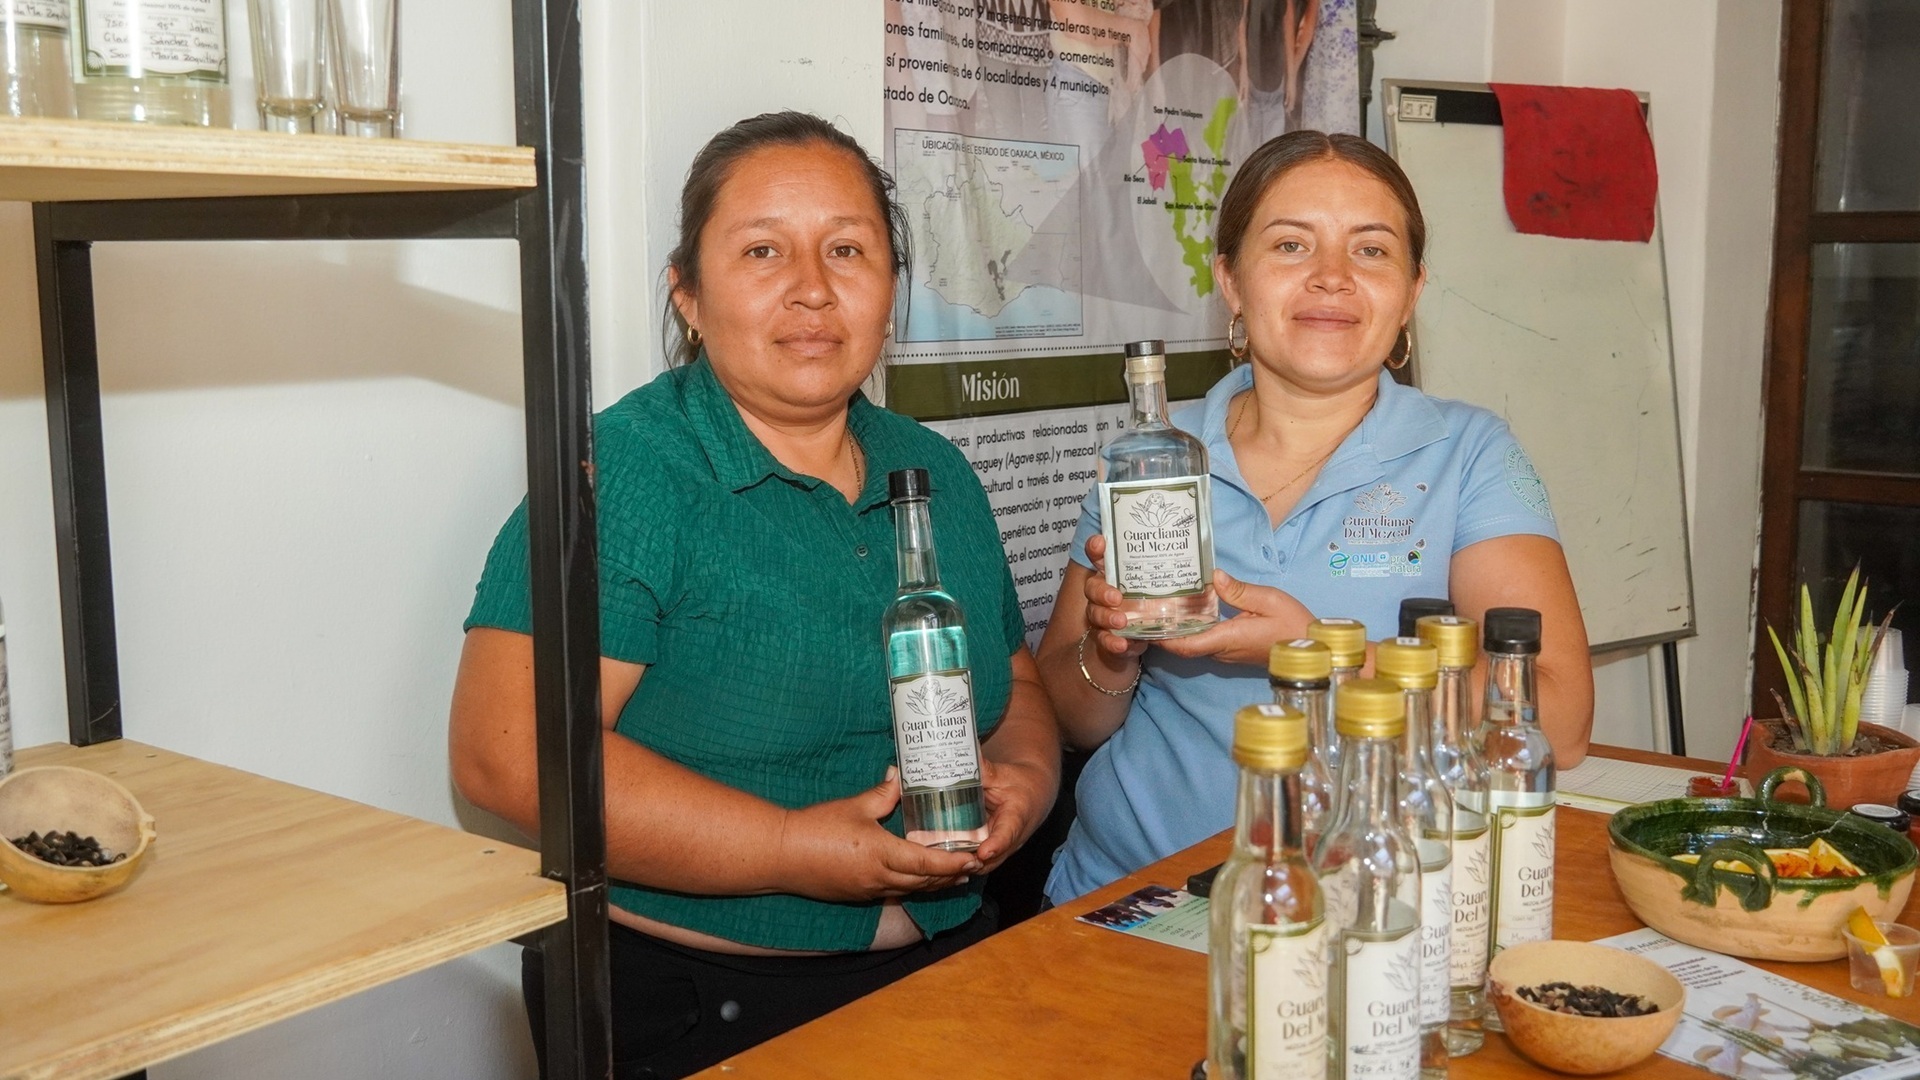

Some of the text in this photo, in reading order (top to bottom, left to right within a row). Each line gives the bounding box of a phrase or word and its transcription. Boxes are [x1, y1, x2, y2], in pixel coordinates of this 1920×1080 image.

[957, 6, 974, 20] por
[977, 5, 985, 19] 9
[986, 8, 1032, 27] maestras
[1033, 17, 1091, 36] mezcaleras
[1091, 26, 1106, 40] que
[1107, 27, 1132, 43] tienen
[886, 22, 914, 37] ones
[962, 32, 975, 49] de
[976, 39, 1046, 61] compadrazgo
[1047, 48, 1054, 60] o
[1059, 51, 1116, 68] comerciales
[886, 52, 896, 68] sí
[961, 63, 973, 80] de
[974, 66, 982, 81] 6
[983, 66, 1041, 88] localidades
[1043, 78, 1049, 93] y
[1050, 76, 1058, 90] 4
[1060, 79, 1110, 98] municipios
[918, 86, 935, 104] de
[1153, 106, 1163, 115] San
[974, 144, 999, 157] ESTADO
[999, 148, 1010, 158] DE
[1040, 149, 1065, 161] MÉXICO
[961, 370, 1020, 402] Misión
[976, 428, 1026, 450] productivas
[1032, 420, 1088, 439] relacionadas
[1116, 415, 1124, 430] la
[971, 456, 1004, 475] maguey
[1005, 451, 1035, 471] (Agave
[1035, 445, 1055, 466] spp.)
[1056, 448, 1062, 462] y
[1063, 440, 1097, 459] mezcal
[1017, 479, 1023, 490] a
[1026, 472, 1050, 488] través
[1052, 469, 1064, 484] de
[992, 498, 1044, 518] conservación
[1045, 499, 1051, 512] y
[1342, 514, 1414, 527] Guardianas
[1001, 519, 1037, 544] genética
[1038, 519, 1049, 533] de
[1123, 527, 1190, 541] Guardianas
[1344, 525, 1411, 539] Del Mezcal
[1020, 546, 1027, 561] el
[1126, 537, 1189, 553] Del Mezcal
[1351, 554, 1376, 563] ONU
[1390, 555, 1407, 565] pro
[1015, 566, 1053, 587] heredada
[1390, 564, 1421, 573] natura
[902, 713, 967, 732] Guardianas
[905, 725, 967, 745] Del Mezcal
[1521, 880, 1544, 898] Del
[1454, 904, 1478, 923] Del
[1423, 937, 1445, 958] Del
[1282, 1014, 1313, 1040] Del
[1372, 1015, 1402, 1037] Del
